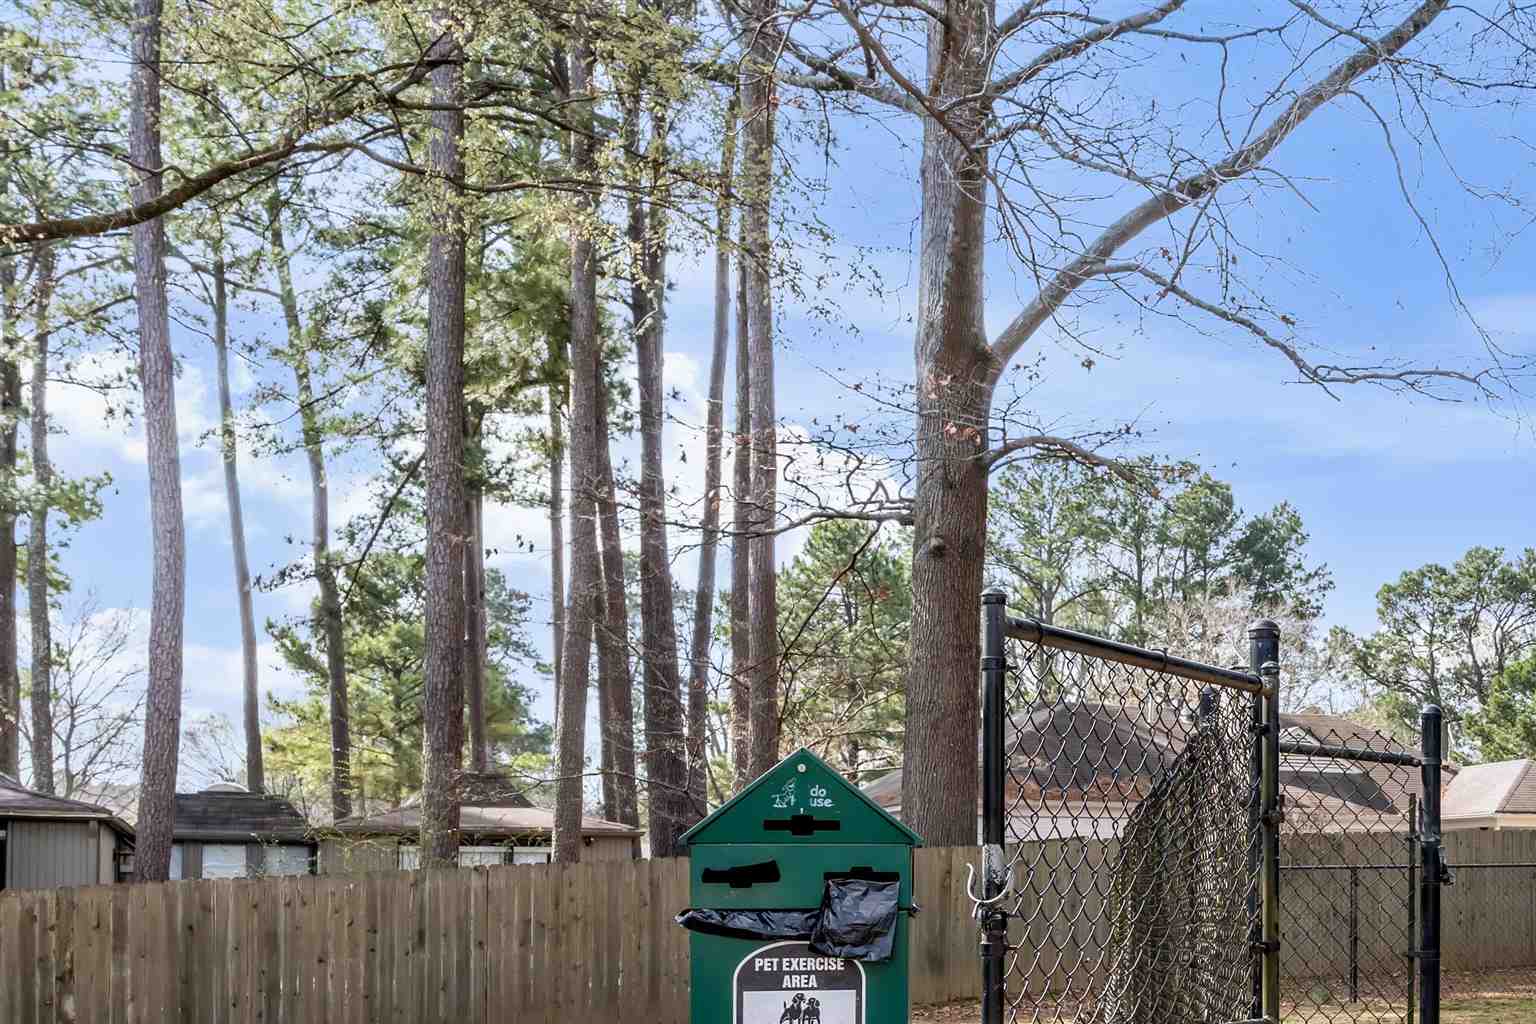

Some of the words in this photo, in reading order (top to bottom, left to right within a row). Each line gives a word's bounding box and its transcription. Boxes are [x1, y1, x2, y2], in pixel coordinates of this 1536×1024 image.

[809, 784, 826, 797] do
[754, 957, 780, 972] PET
[782, 957, 845, 971] EXERCISE
[781, 974, 819, 988] AREA
